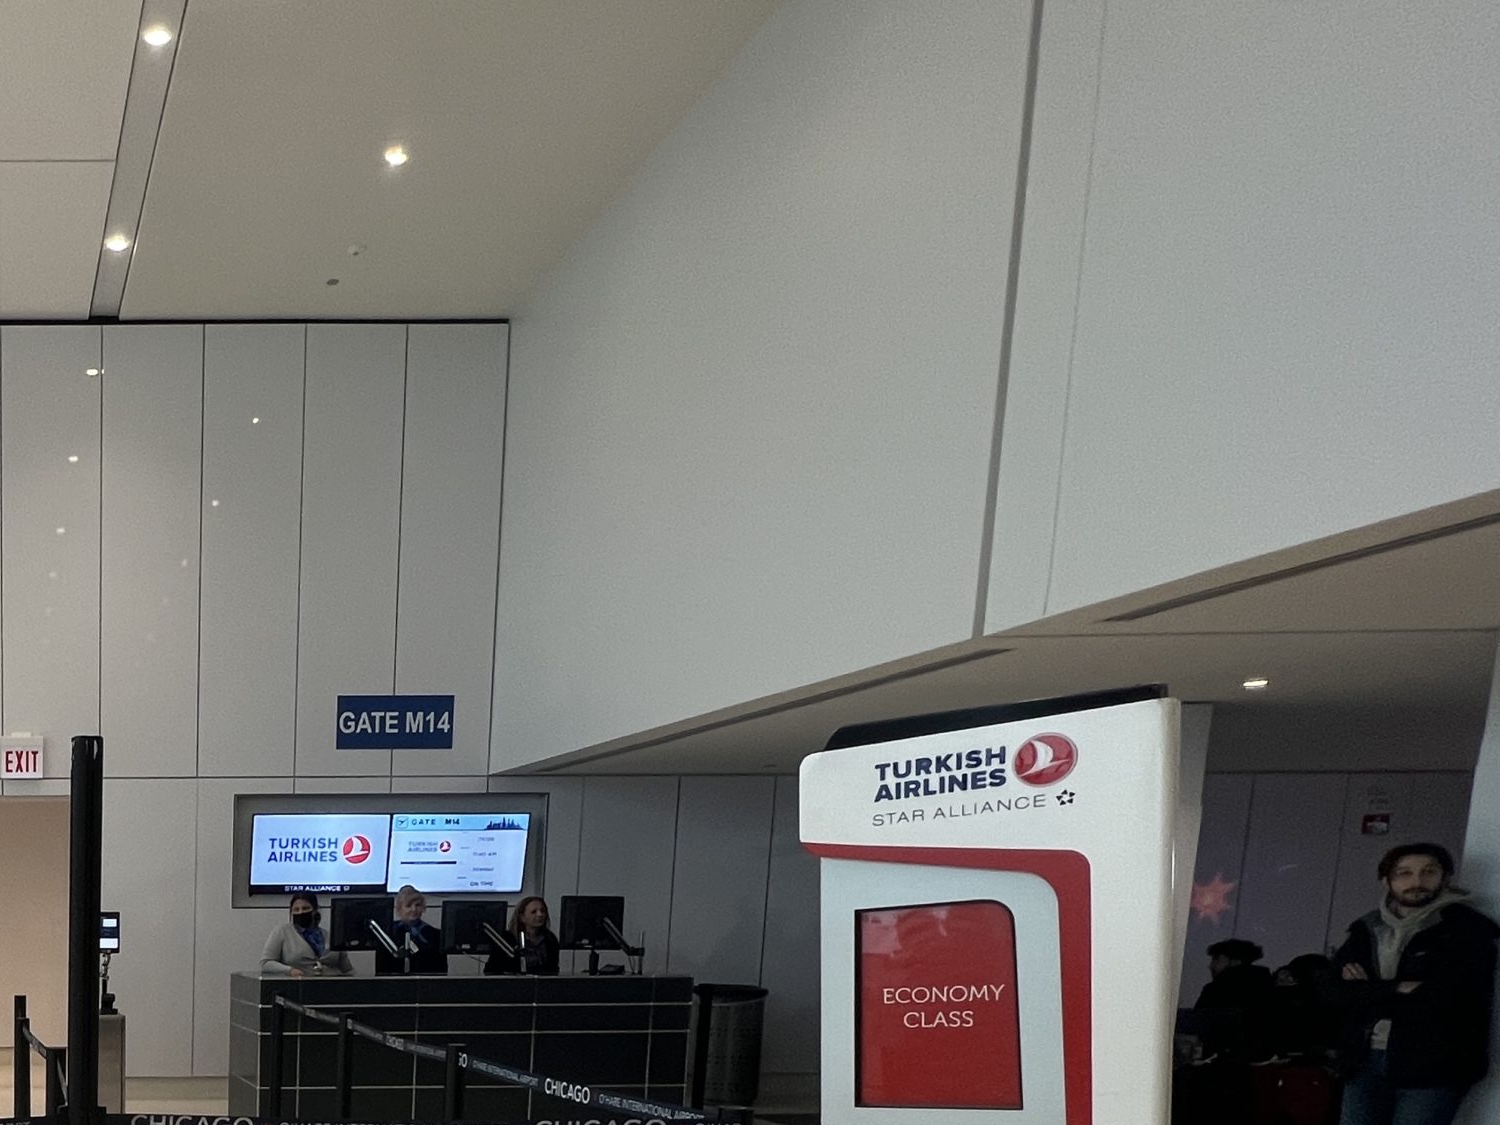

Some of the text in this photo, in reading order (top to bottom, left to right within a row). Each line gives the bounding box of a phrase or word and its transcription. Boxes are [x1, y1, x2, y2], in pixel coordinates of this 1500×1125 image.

[339, 711, 451, 735] GATE M14
[5, 750, 39, 773] EXIT
[874, 746, 1007, 782] TURKISH
[874, 768, 1007, 803] AIRLINES
[872, 794, 1047, 828] STAR ALLIANCE
[269, 837, 338, 850] TURKISH
[268, 851, 338, 863] AIRLINES
[883, 984, 1005, 1005] ECONOMY
[903, 1011, 974, 1029] CLASS
[545, 1078, 590, 1104] CHICAGO
[622, 1099, 672, 1119] INTERNATIONAL
